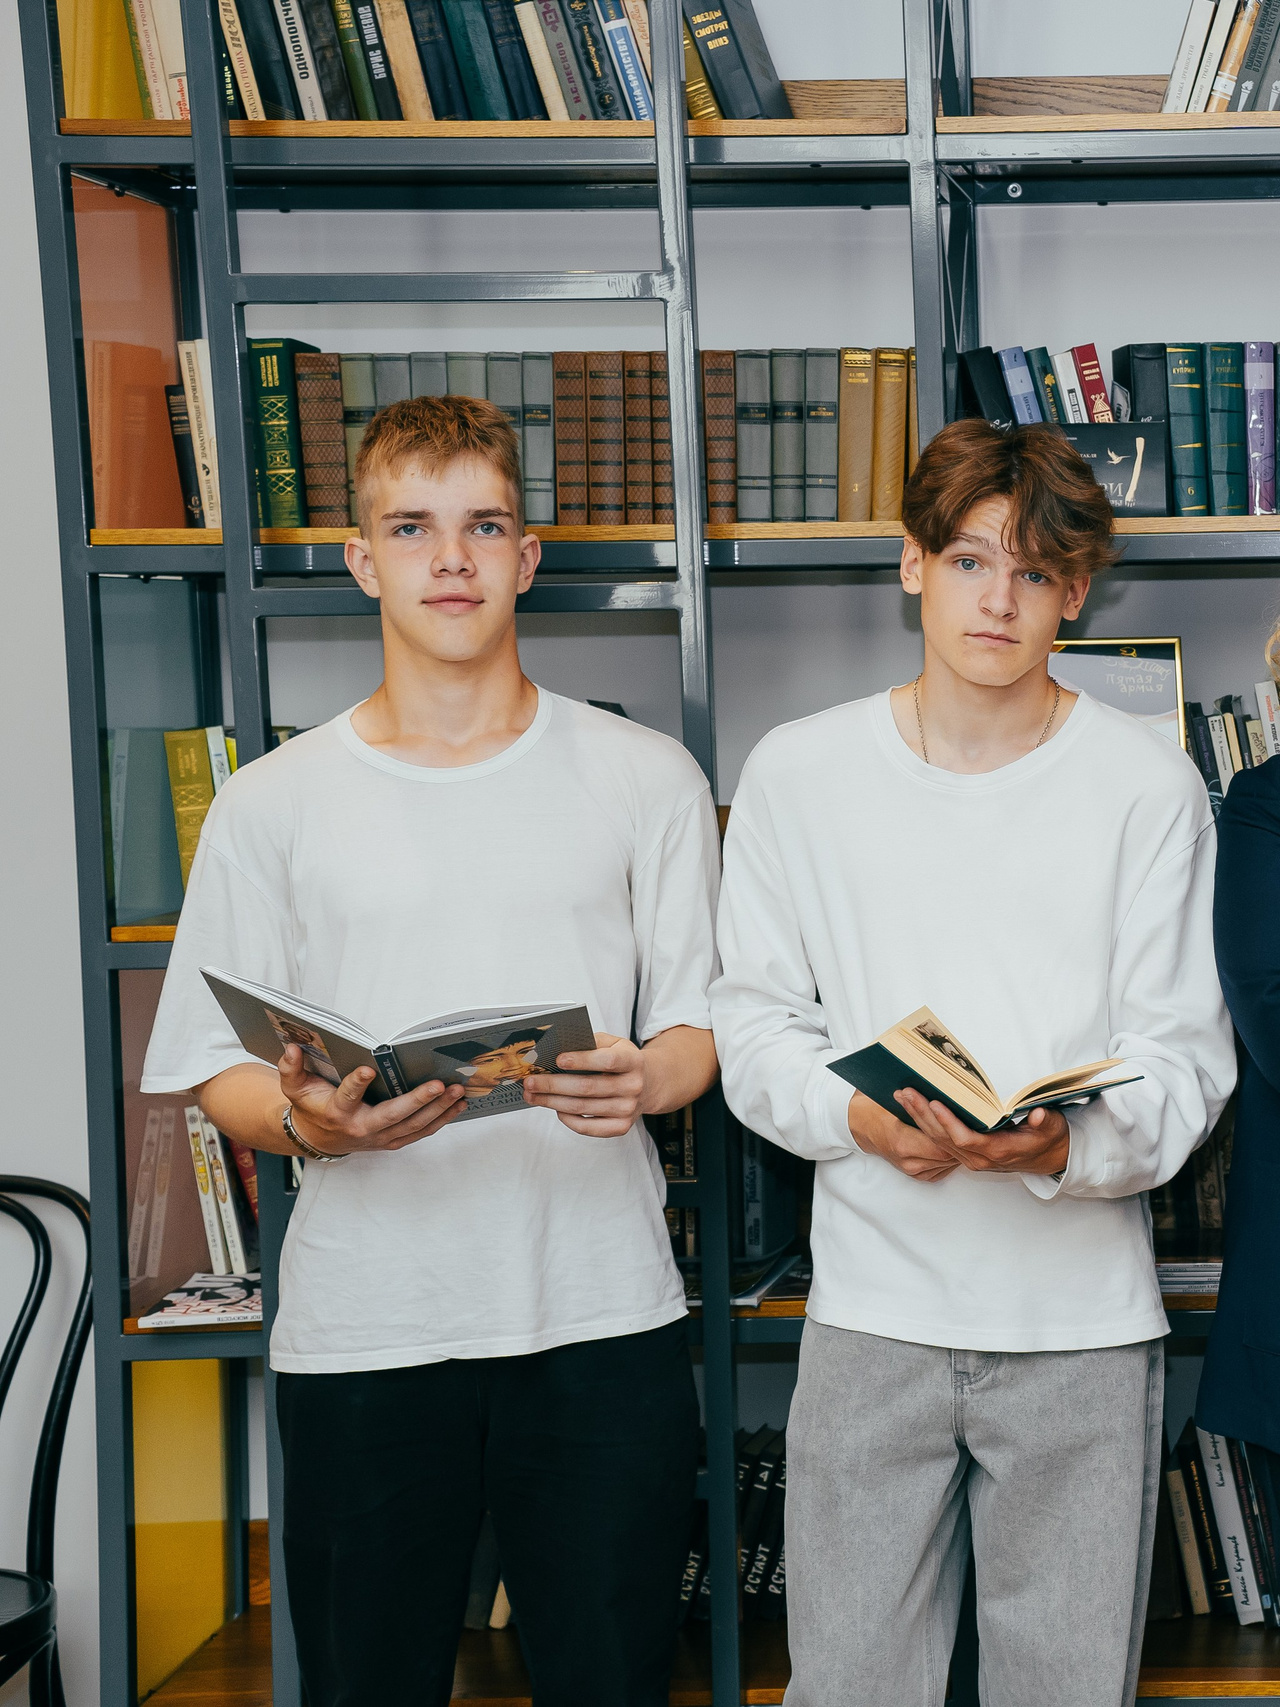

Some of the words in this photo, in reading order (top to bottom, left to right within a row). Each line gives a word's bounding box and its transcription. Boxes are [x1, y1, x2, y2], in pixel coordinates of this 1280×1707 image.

[358, 5, 379, 45] ПОЛЕВОЙ
[691, 9, 722, 25] ЗВЕЗДЫ
[695, 20, 729, 38] СМОТРЯТ
[280, 0, 309, 79] ОДНОПОЛЧА
[706, 36, 729, 50] ВНИЗ
[235, 49, 249, 80] ТВОИХ
[369, 50, 387, 79] БОРИС
[616, 37, 639, 87] БРАТСТВА
[1252, 41, 1269, 73] ВЕЛИКОЙ
[555, 42, 581, 104] Н.С.ЛЕСКОВ
[185, 351, 200, 403] ПРОИЗВЕДЕНИЯ
[193, 404, 208, 460] ДРАМАТИЧЕСКИЕ
[1187, 486, 1195, 496] 6
[1215, 1463, 1225, 1487] Книга
[1227, 1535, 1245, 1572] Казанцев
[1236, 1576, 1250, 1605] Алексей
